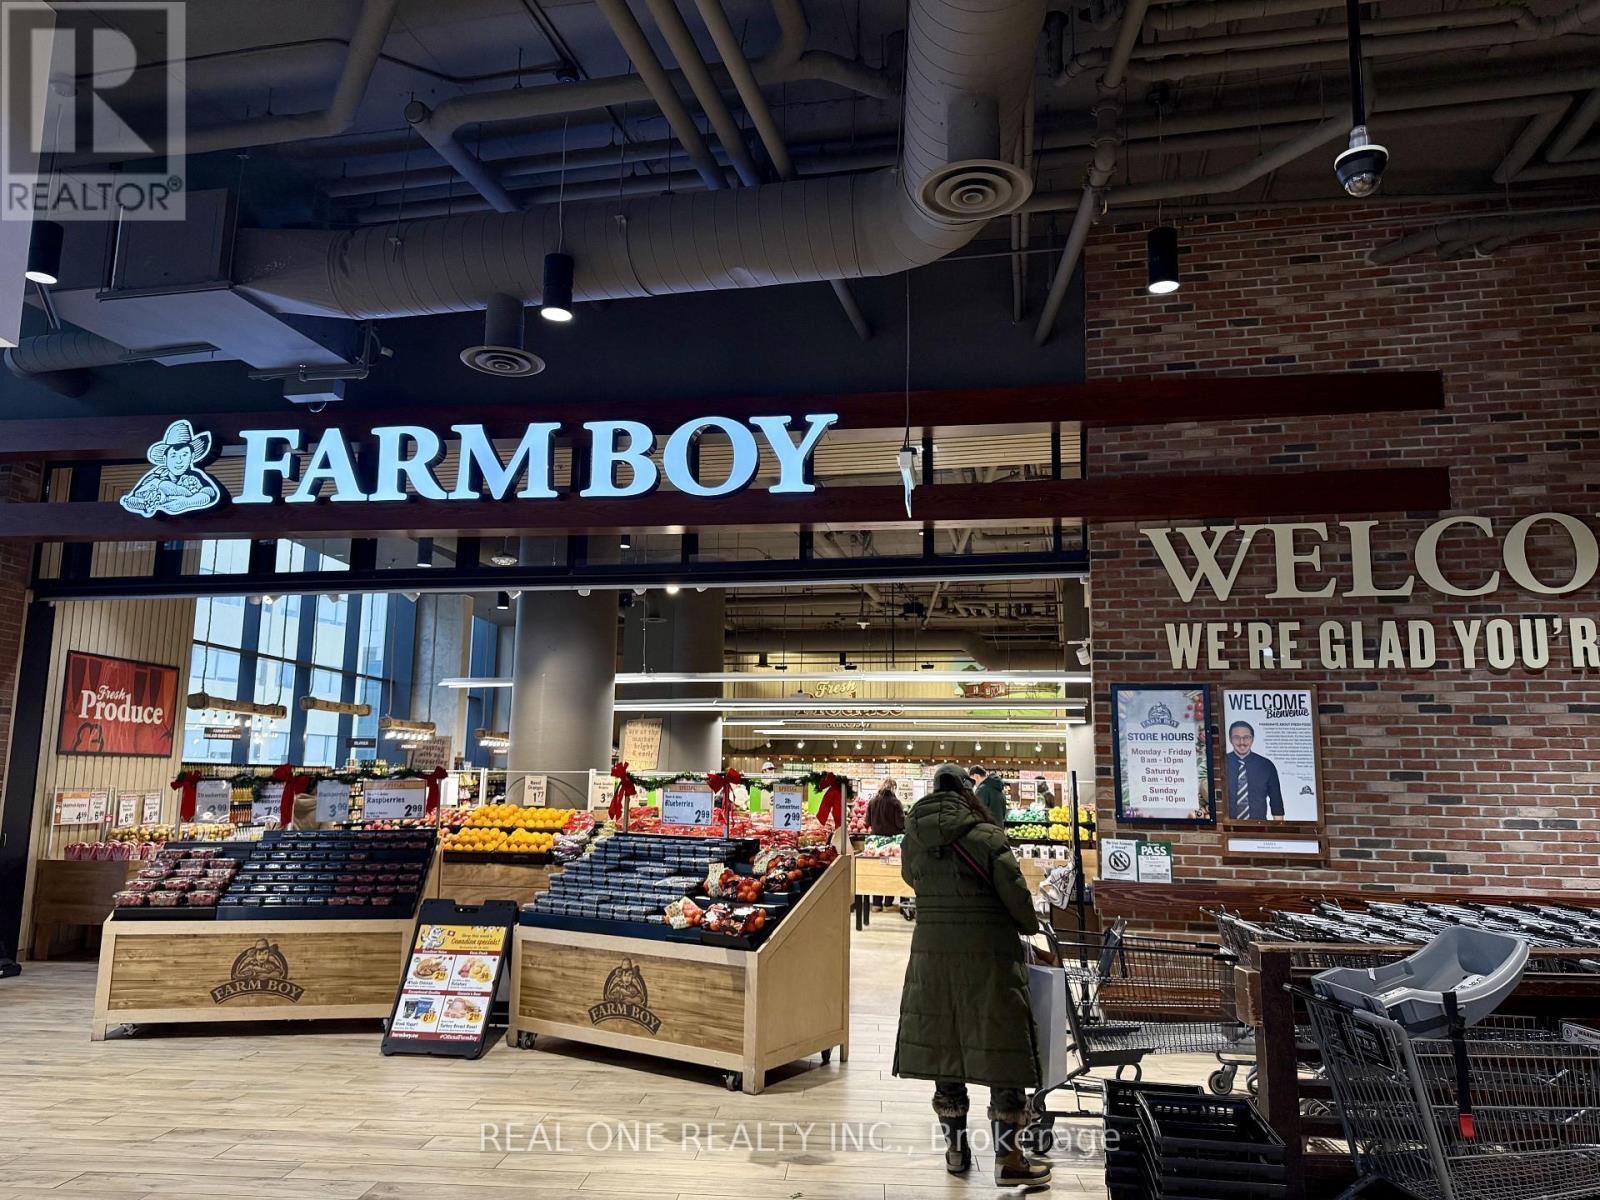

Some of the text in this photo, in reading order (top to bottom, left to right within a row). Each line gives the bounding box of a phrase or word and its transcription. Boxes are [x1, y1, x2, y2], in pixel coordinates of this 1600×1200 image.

[232, 413, 838, 503] FARM BOY
[1139, 512, 1600, 602] WELCO
[1165, 622, 1301, 670] WE'RE
[1319, 620, 1436, 670] GLAD
[97, 685, 126, 701] Fresh
[814, 680, 856, 698] Fresh
[79, 690, 163, 725] Produce
[1228, 693, 1307, 710] WELCOME
[1265, 707, 1309, 719] Bienvenue
[1128, 732, 1194, 741] STORE HOURS
[1131, 748, 1161, 756] Monday
[1168, 748, 1192, 756] Friday
[1145, 767, 1180, 775] Saturday
[1149, 787, 1178, 795] Sunday
[366, 796, 405, 804] Raspberries
[664, 799, 694, 808] Blueberries
[404, 804, 423, 817] 299
[694, 809, 710, 824] 299
[784, 812, 801, 827] 299
[1141, 846, 1167, 856] PASS
[213, 979, 302, 1000] FARM BOY
[591, 1002, 659, 1030] FARM BOY
